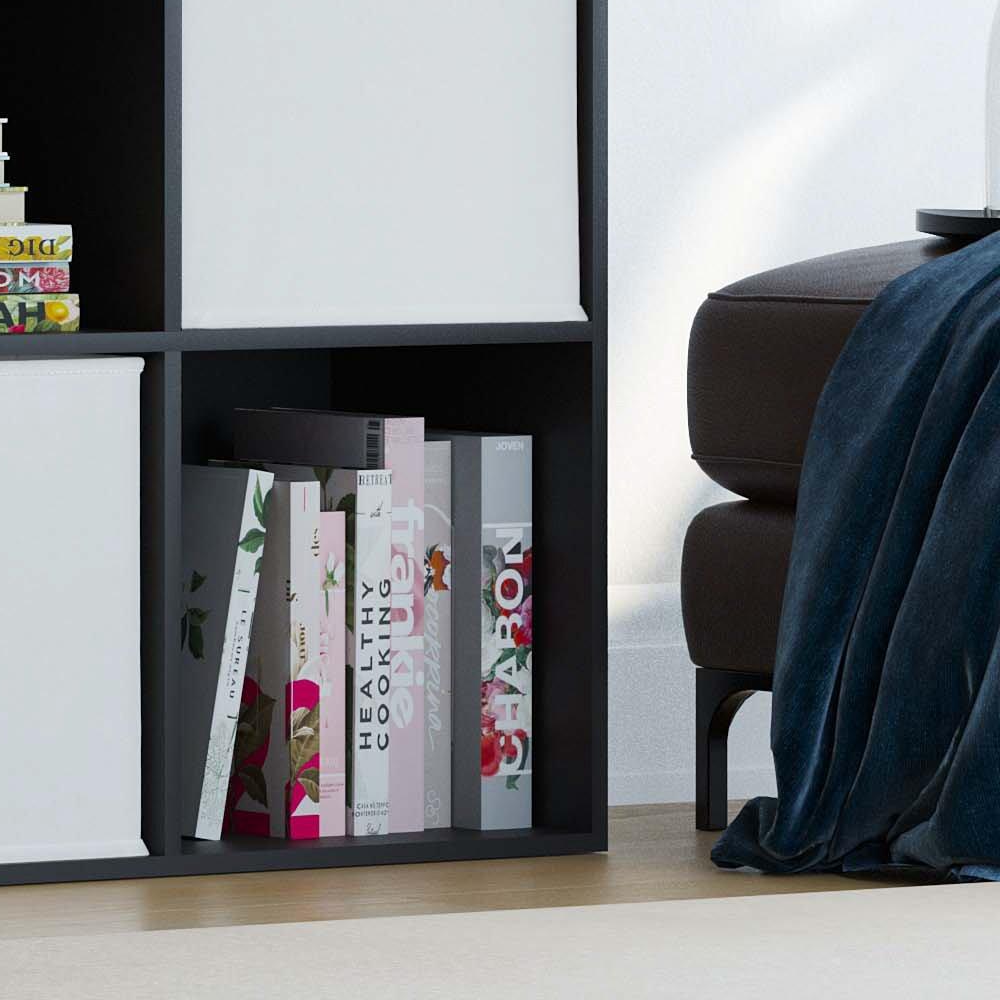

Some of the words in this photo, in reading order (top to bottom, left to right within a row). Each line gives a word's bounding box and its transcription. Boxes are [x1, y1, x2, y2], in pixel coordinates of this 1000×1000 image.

[9, 238, 57, 256] DIG
[359, 580, 374, 750] HEALTHY
[377, 578, 391, 751] COOKING
[391, 499, 424, 729] frankie
[494, 527, 526, 774] CHABON
